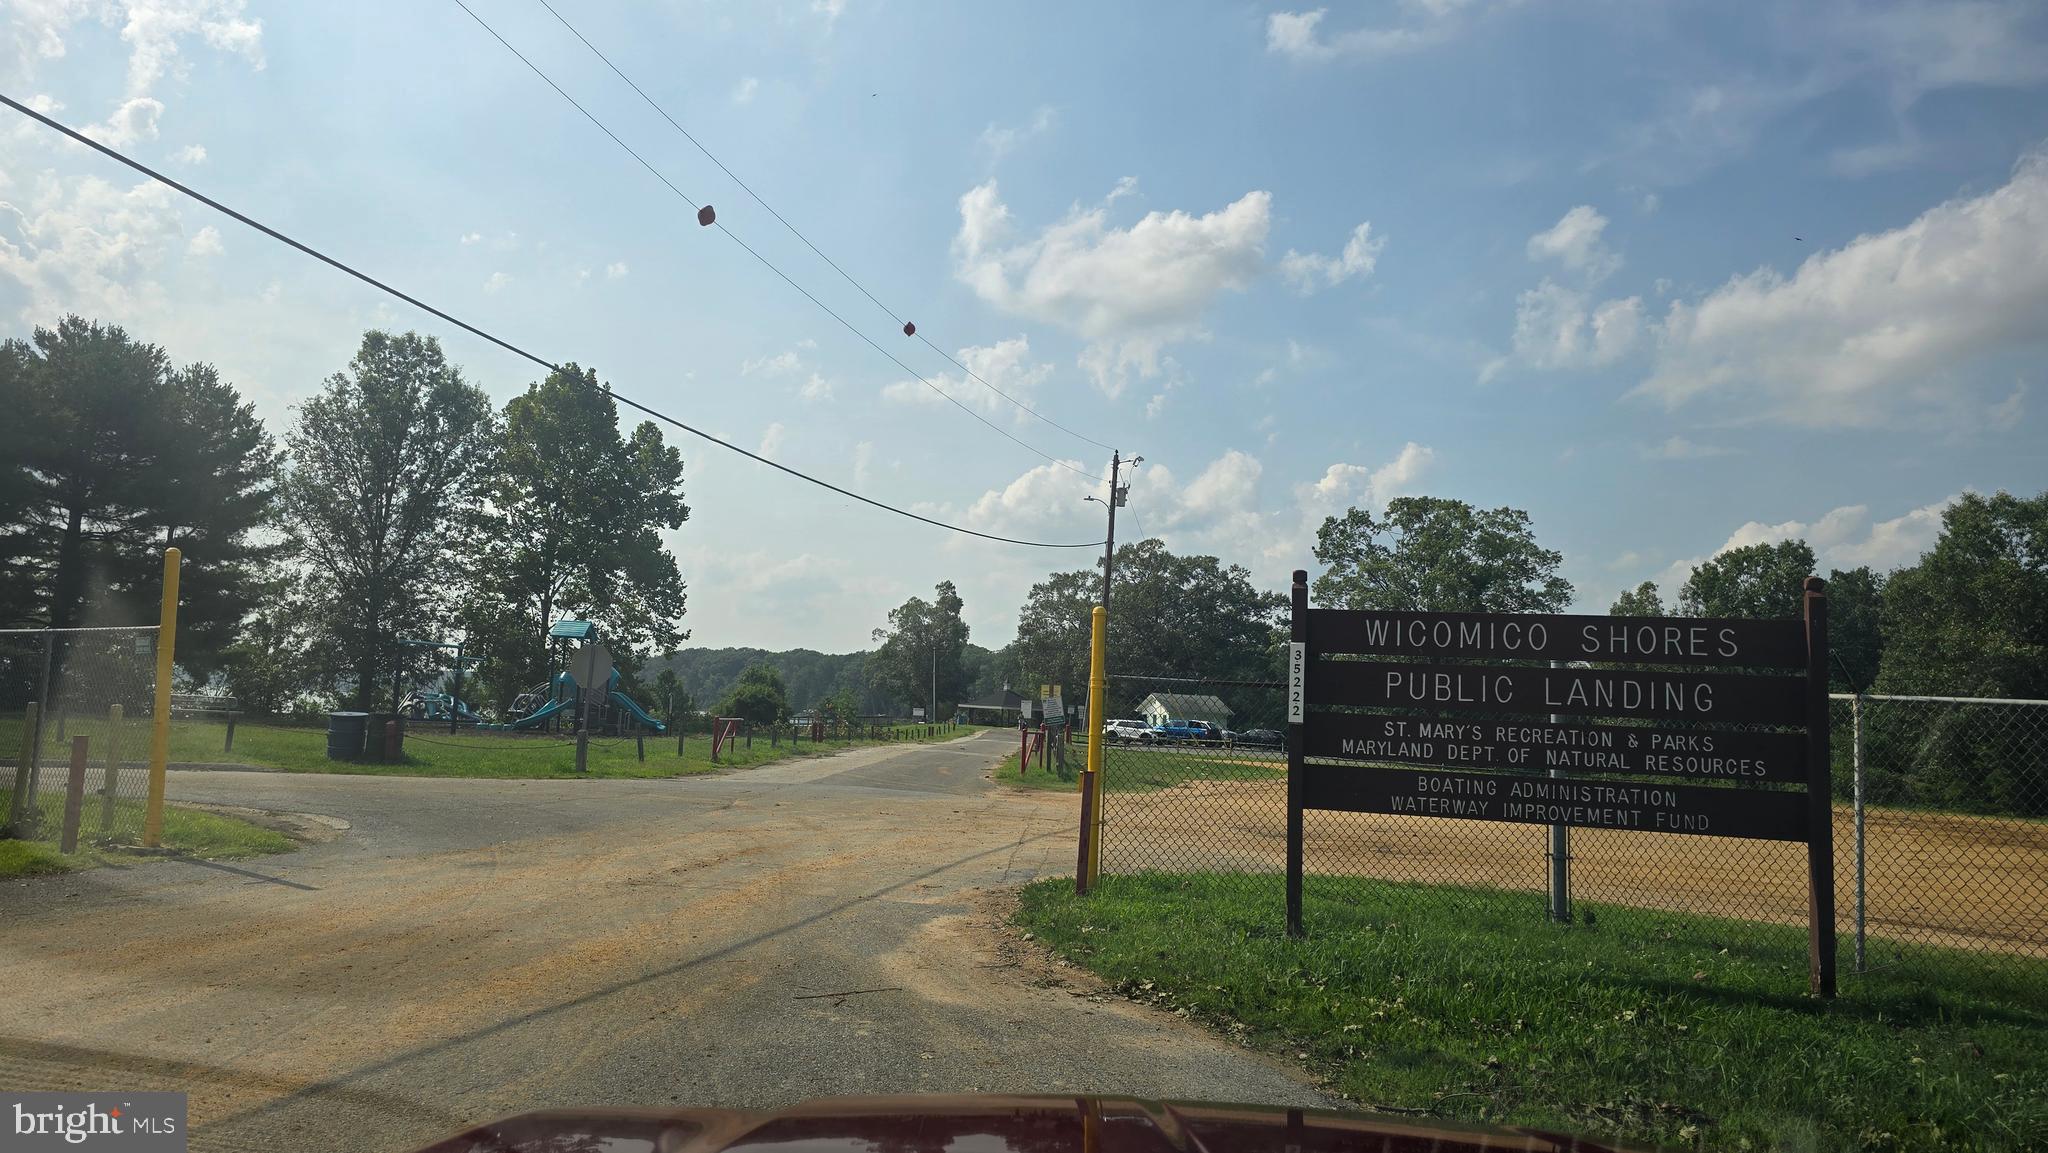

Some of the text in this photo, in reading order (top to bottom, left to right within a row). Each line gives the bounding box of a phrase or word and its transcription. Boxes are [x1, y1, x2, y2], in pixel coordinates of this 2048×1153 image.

[1366, 619, 1738, 657] WICOMICO SHORES
[1292, 650, 1302, 716] 35222
[1386, 672, 1713, 712] PUBLIC LANDING
[1384, 721, 1714, 752] ST. MARY'S RECREATION & PARKS
[1342, 739, 1766, 777] MARYLAND DEPT. OF NATURAL RESOURCES
[1418, 776, 1676, 807] BOATING ADMINISTRATION
[1391, 795, 1710, 831] WATERWAY IMPROVEMENT FUND
